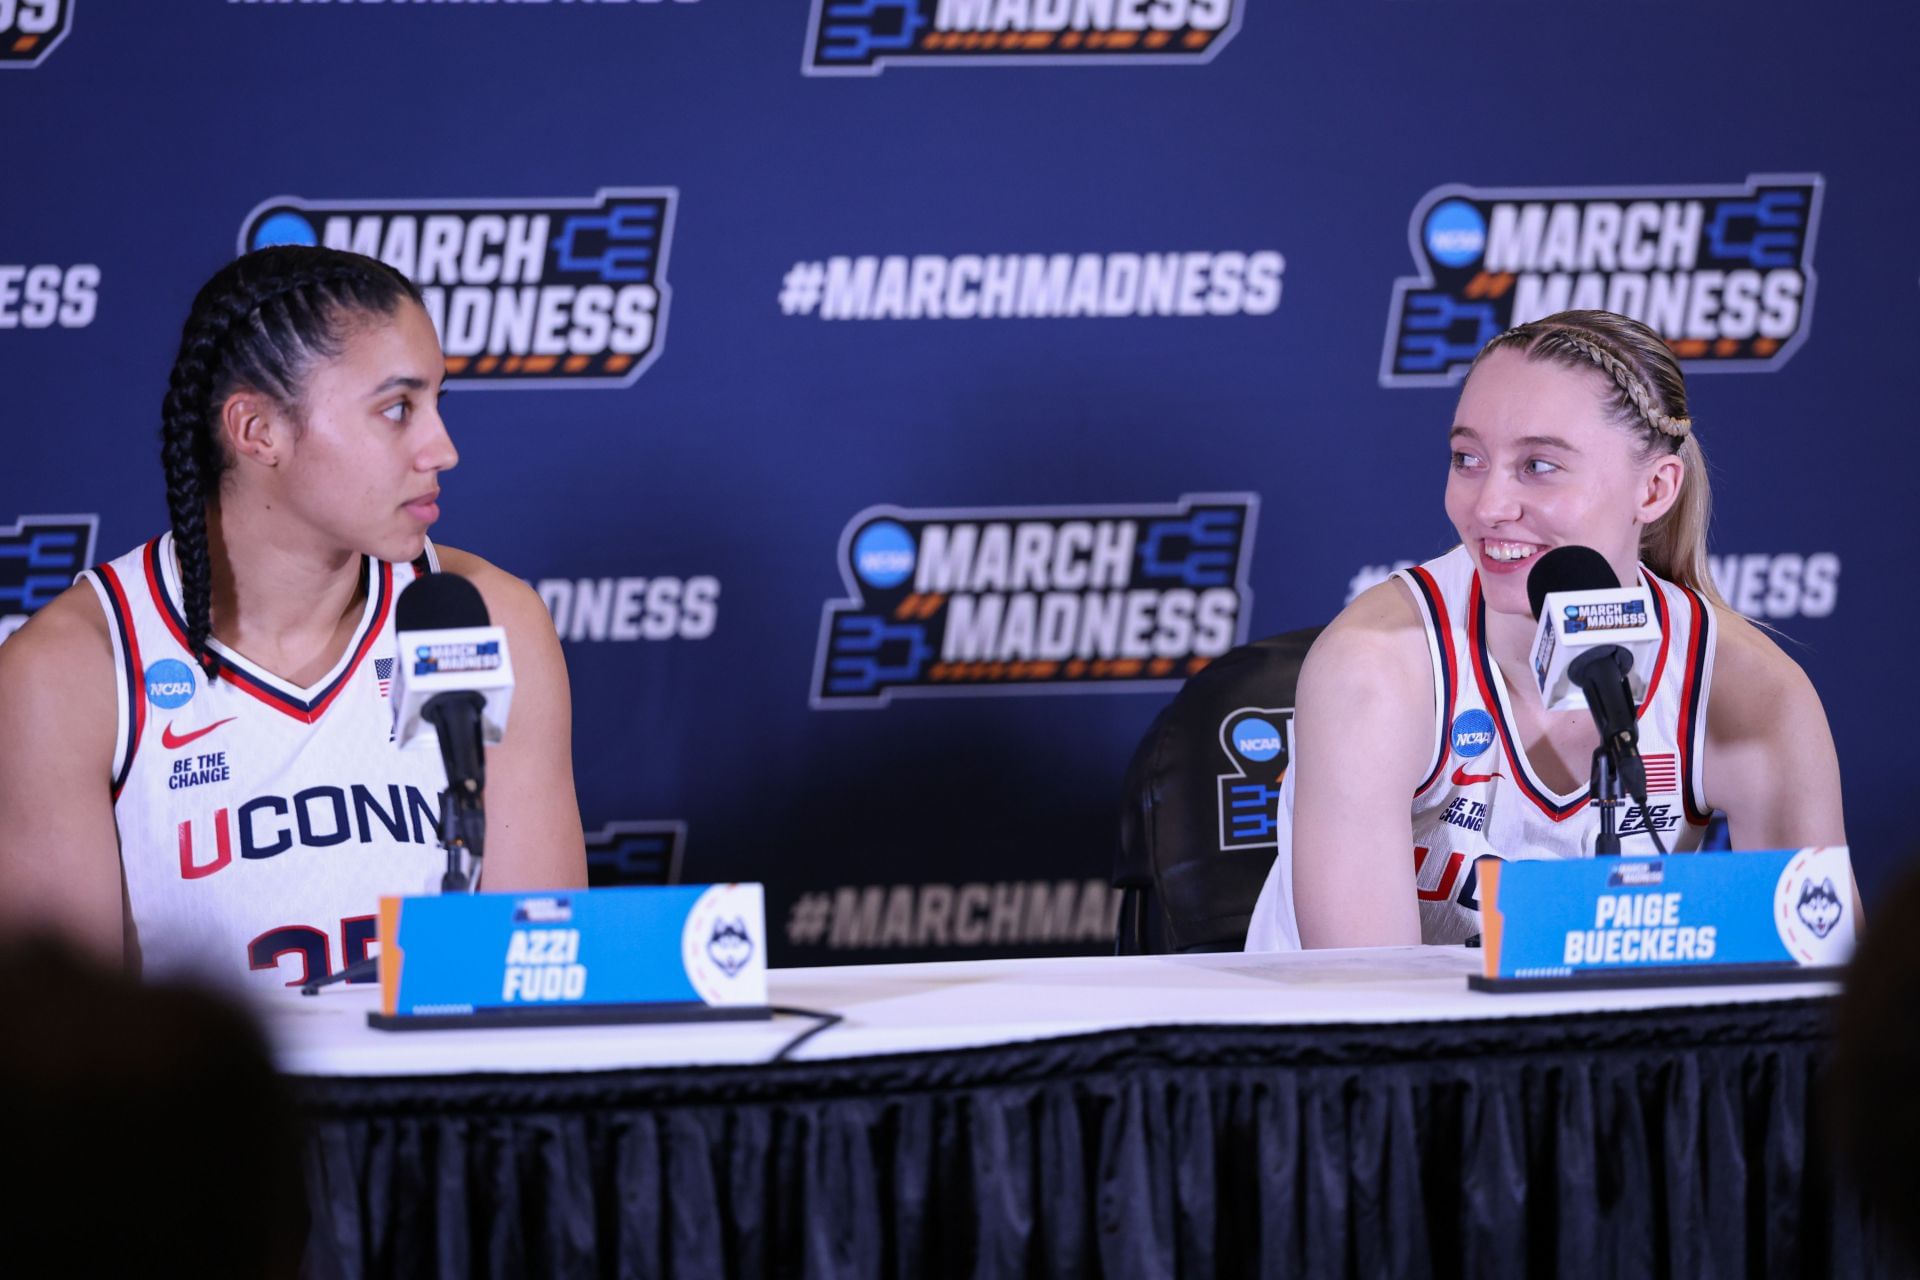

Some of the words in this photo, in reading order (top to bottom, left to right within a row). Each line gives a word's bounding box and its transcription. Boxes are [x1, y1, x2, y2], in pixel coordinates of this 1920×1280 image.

[1483, 201, 1704, 273] MARCH
[778, 250, 1286, 320] #MARCHMADNESS
[914, 520, 1137, 594] MARCH
[941, 587, 1237, 663] MADNESS
[1578, 604, 1622, 617] MARCH
[1586, 613, 1646, 628] MADNESS
[150, 682, 193, 696] NCAA
[1240, 738, 1281, 752] NCAA
[1456, 732, 1490, 746] NCAA
[168, 766, 230, 790] CHANGE
[173, 757, 193, 774] BE
[197, 751, 226, 769] THE
[1449, 797, 1468, 812] BE
[178, 784, 447, 880] UCONN
[1595, 893, 1681, 928] PAIGE
[505, 928, 580, 966] AZZI
[1563, 926, 1716, 964] BUECKERS
[502, 964, 587, 1002] FUDD
